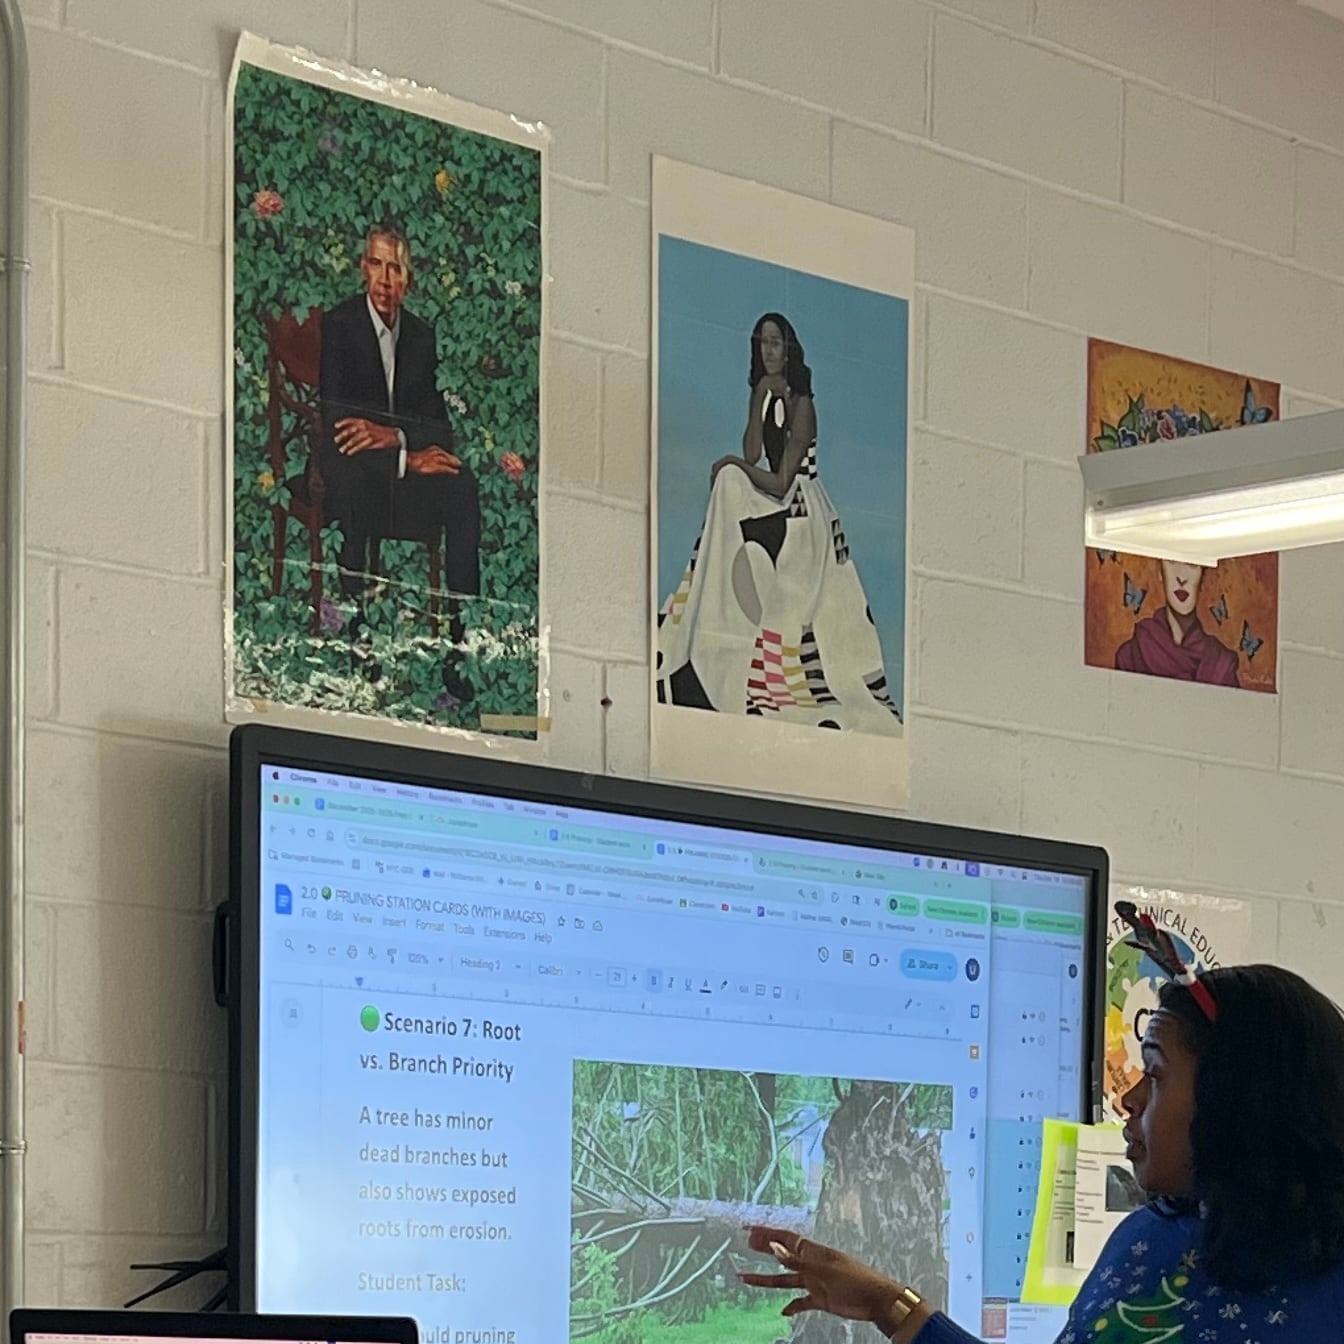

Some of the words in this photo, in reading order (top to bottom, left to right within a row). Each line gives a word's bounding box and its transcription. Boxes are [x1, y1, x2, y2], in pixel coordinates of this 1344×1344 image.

[335, 889, 384, 908] PRUNING
[386, 896, 431, 912] STATION
[433, 901, 470, 917] CARDS
[471, 906, 501, 920] (WITH
[503, 909, 546, 926] IMAGES)
[416, 919, 445, 932] Format
[483, 926, 526, 941] Extensions
[534, 932, 552, 945] Help
[384, 1012, 457, 1037] Scenario
[462, 1018, 478, 1038] 7:
[483, 1020, 522, 1042] Root
[360, 1053, 383, 1071] vs.
[389, 1051, 448, 1075] Branch
[452, 1055, 514, 1083] Priority
[359, 1106, 371, 1125] A
[376, 1109, 409, 1127] tree
[414, 1108, 441, 1128] has
[446, 1111, 493, 1131] minor
[360, 1144, 400, 1164] dead
[405, 1145, 477, 1168] branches
[481, 1148, 508, 1168] but
[359, 1181, 392, 1201] also
[396, 1182, 447, 1203] shows
[451, 1186, 516, 1208] exposed
[359, 1218, 401, 1239] roots
[405, 1219, 444, 1240] from
[449, 1220, 512, 1241] erosion.
[358, 1272, 422, 1291] Student
[427, 1274, 467, 1292] Task:
